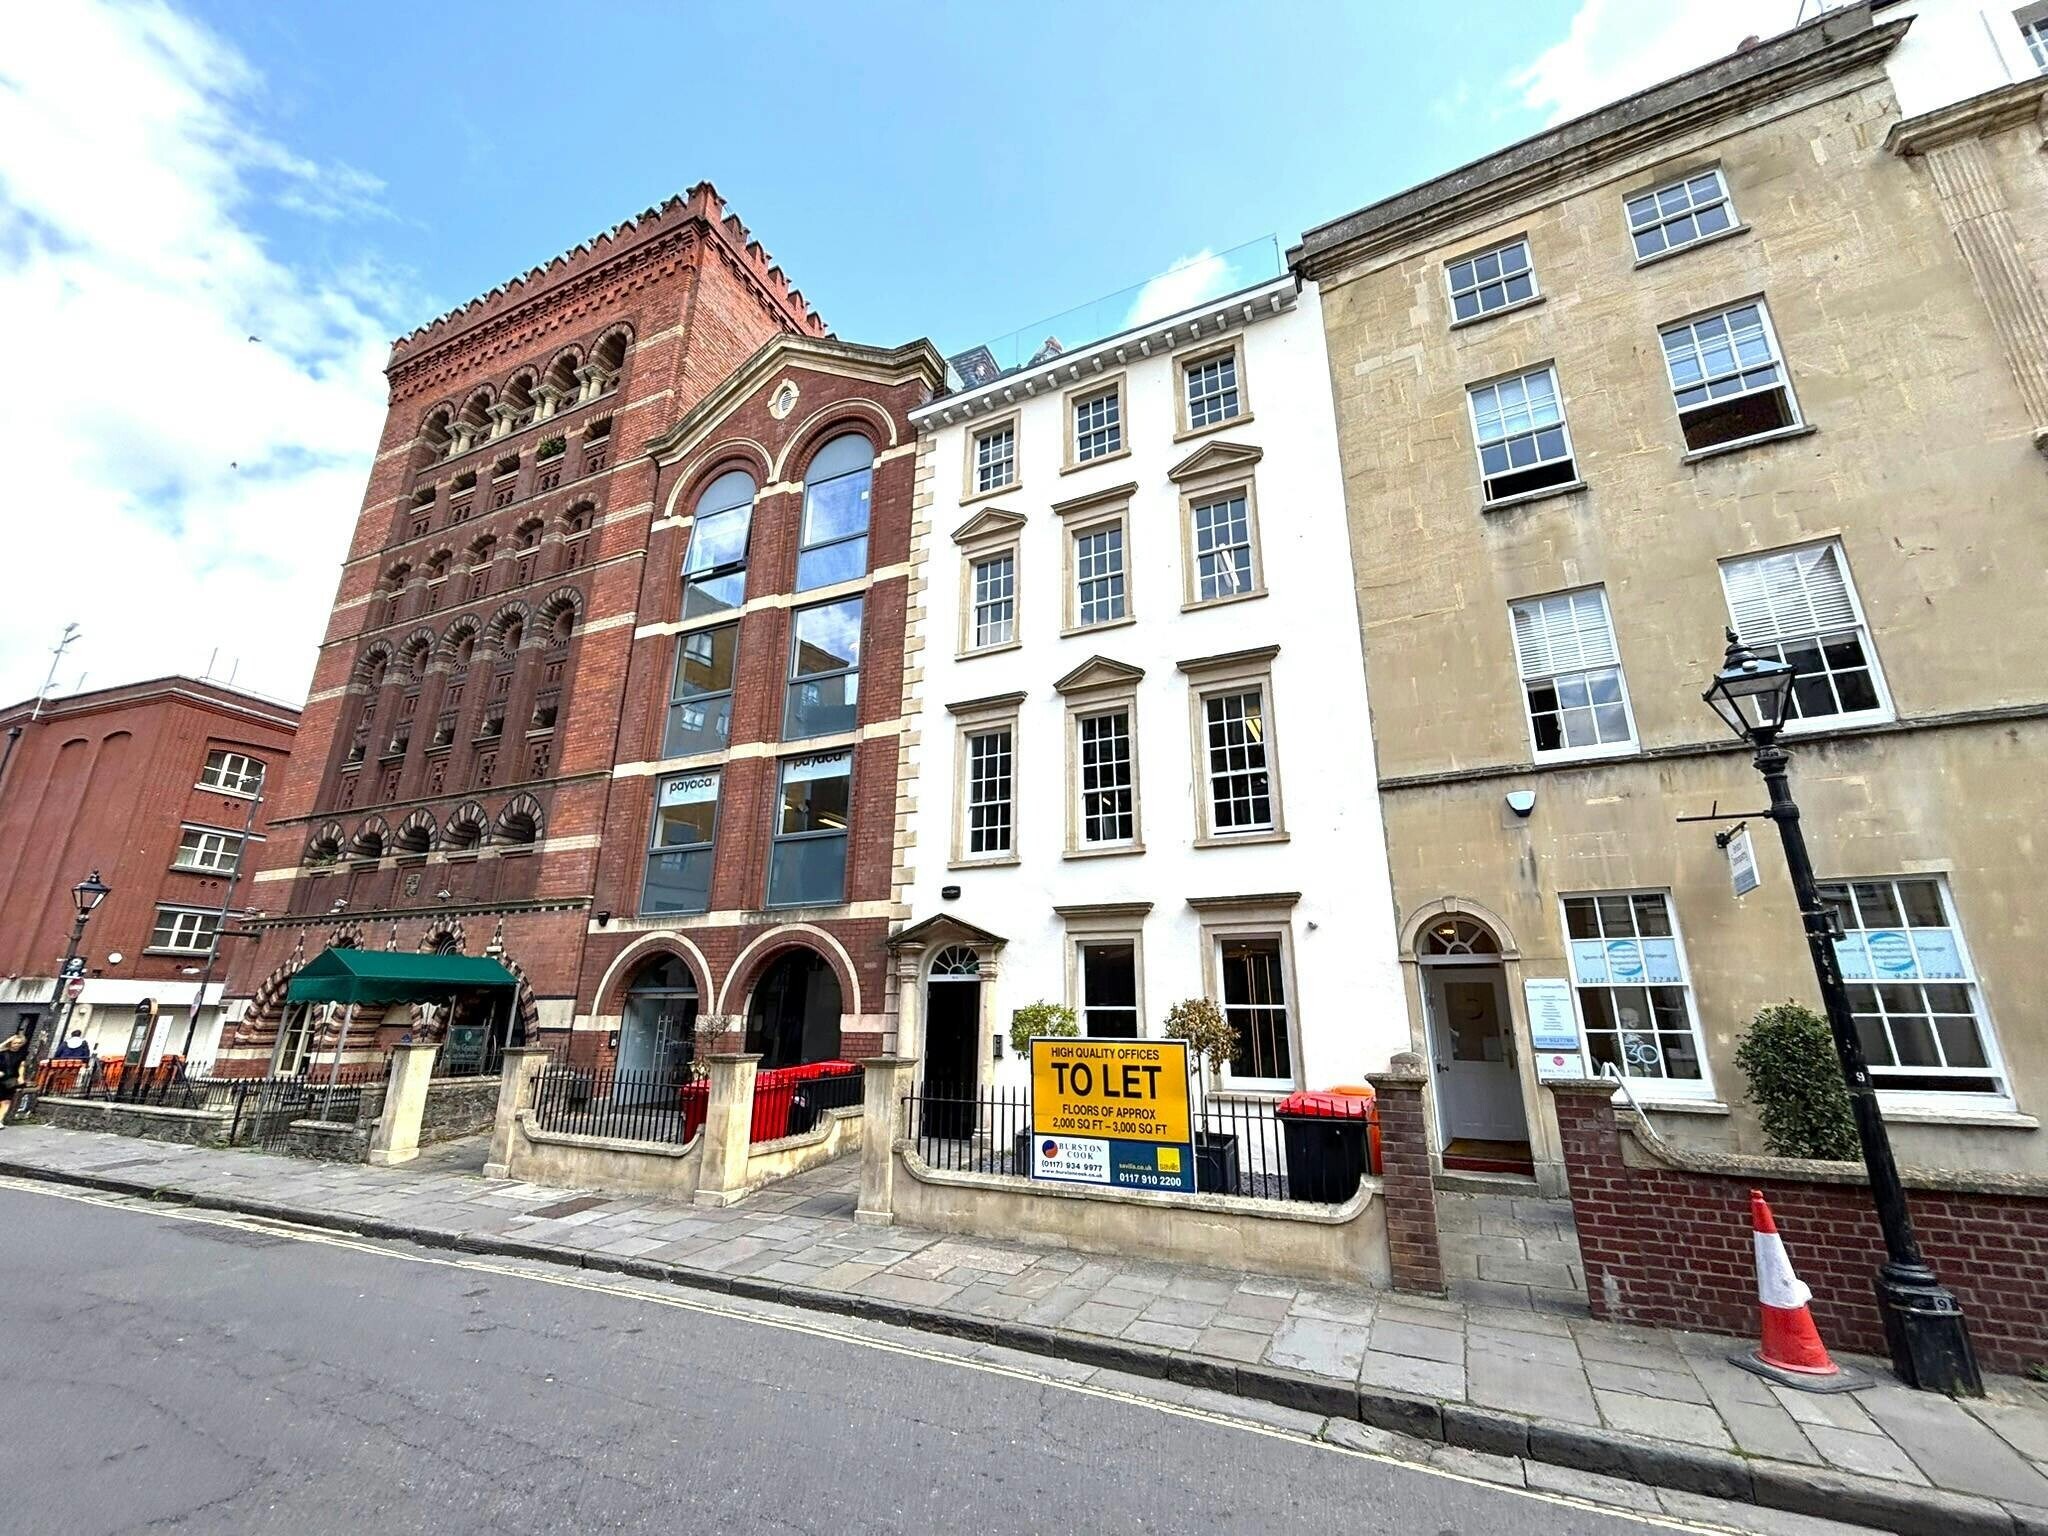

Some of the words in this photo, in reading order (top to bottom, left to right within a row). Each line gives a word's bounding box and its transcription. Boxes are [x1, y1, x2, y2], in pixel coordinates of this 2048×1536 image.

[1051, 1047, 1074, 1058] HIGH
[1075, 1048, 1115, 1059] QUALITY
[1118, 1049, 1160, 1060] OFFICES
[1051, 1062, 1093, 1097] TO
[1103, 1064, 1162, 1100] LET
[1062, 1104, 1099, 1116] FLOORS
[1102, 1106, 1114, 1117] OF
[1116, 1107, 1156, 1120] APPROX
[1053, 1117, 1075, 1129] 2,000
[1077, 1118, 1091, 1130] SQ
[1092, 1120, 1103, 1131] FT
[1113, 1122, 1136, 1134] 3,000
[1139, 1123, 1153, 1135] SQ
[1156, 1124, 1168, 1136] FT
[1059, 1142, 1103, 1152] BURSTON
[1067, 1151, 1094, 1160] COOK
[1041, 1160, 1063, 1168] (0117)
[1066, 1162, 1081, 1170] 934
[1083, 1164, 1103, 1172] 9977
[1119, 1173, 1140, 1183] 0117
[1141, 1174, 1158, 1185] 910
[1159, 1176, 1182, 1187] 2200
